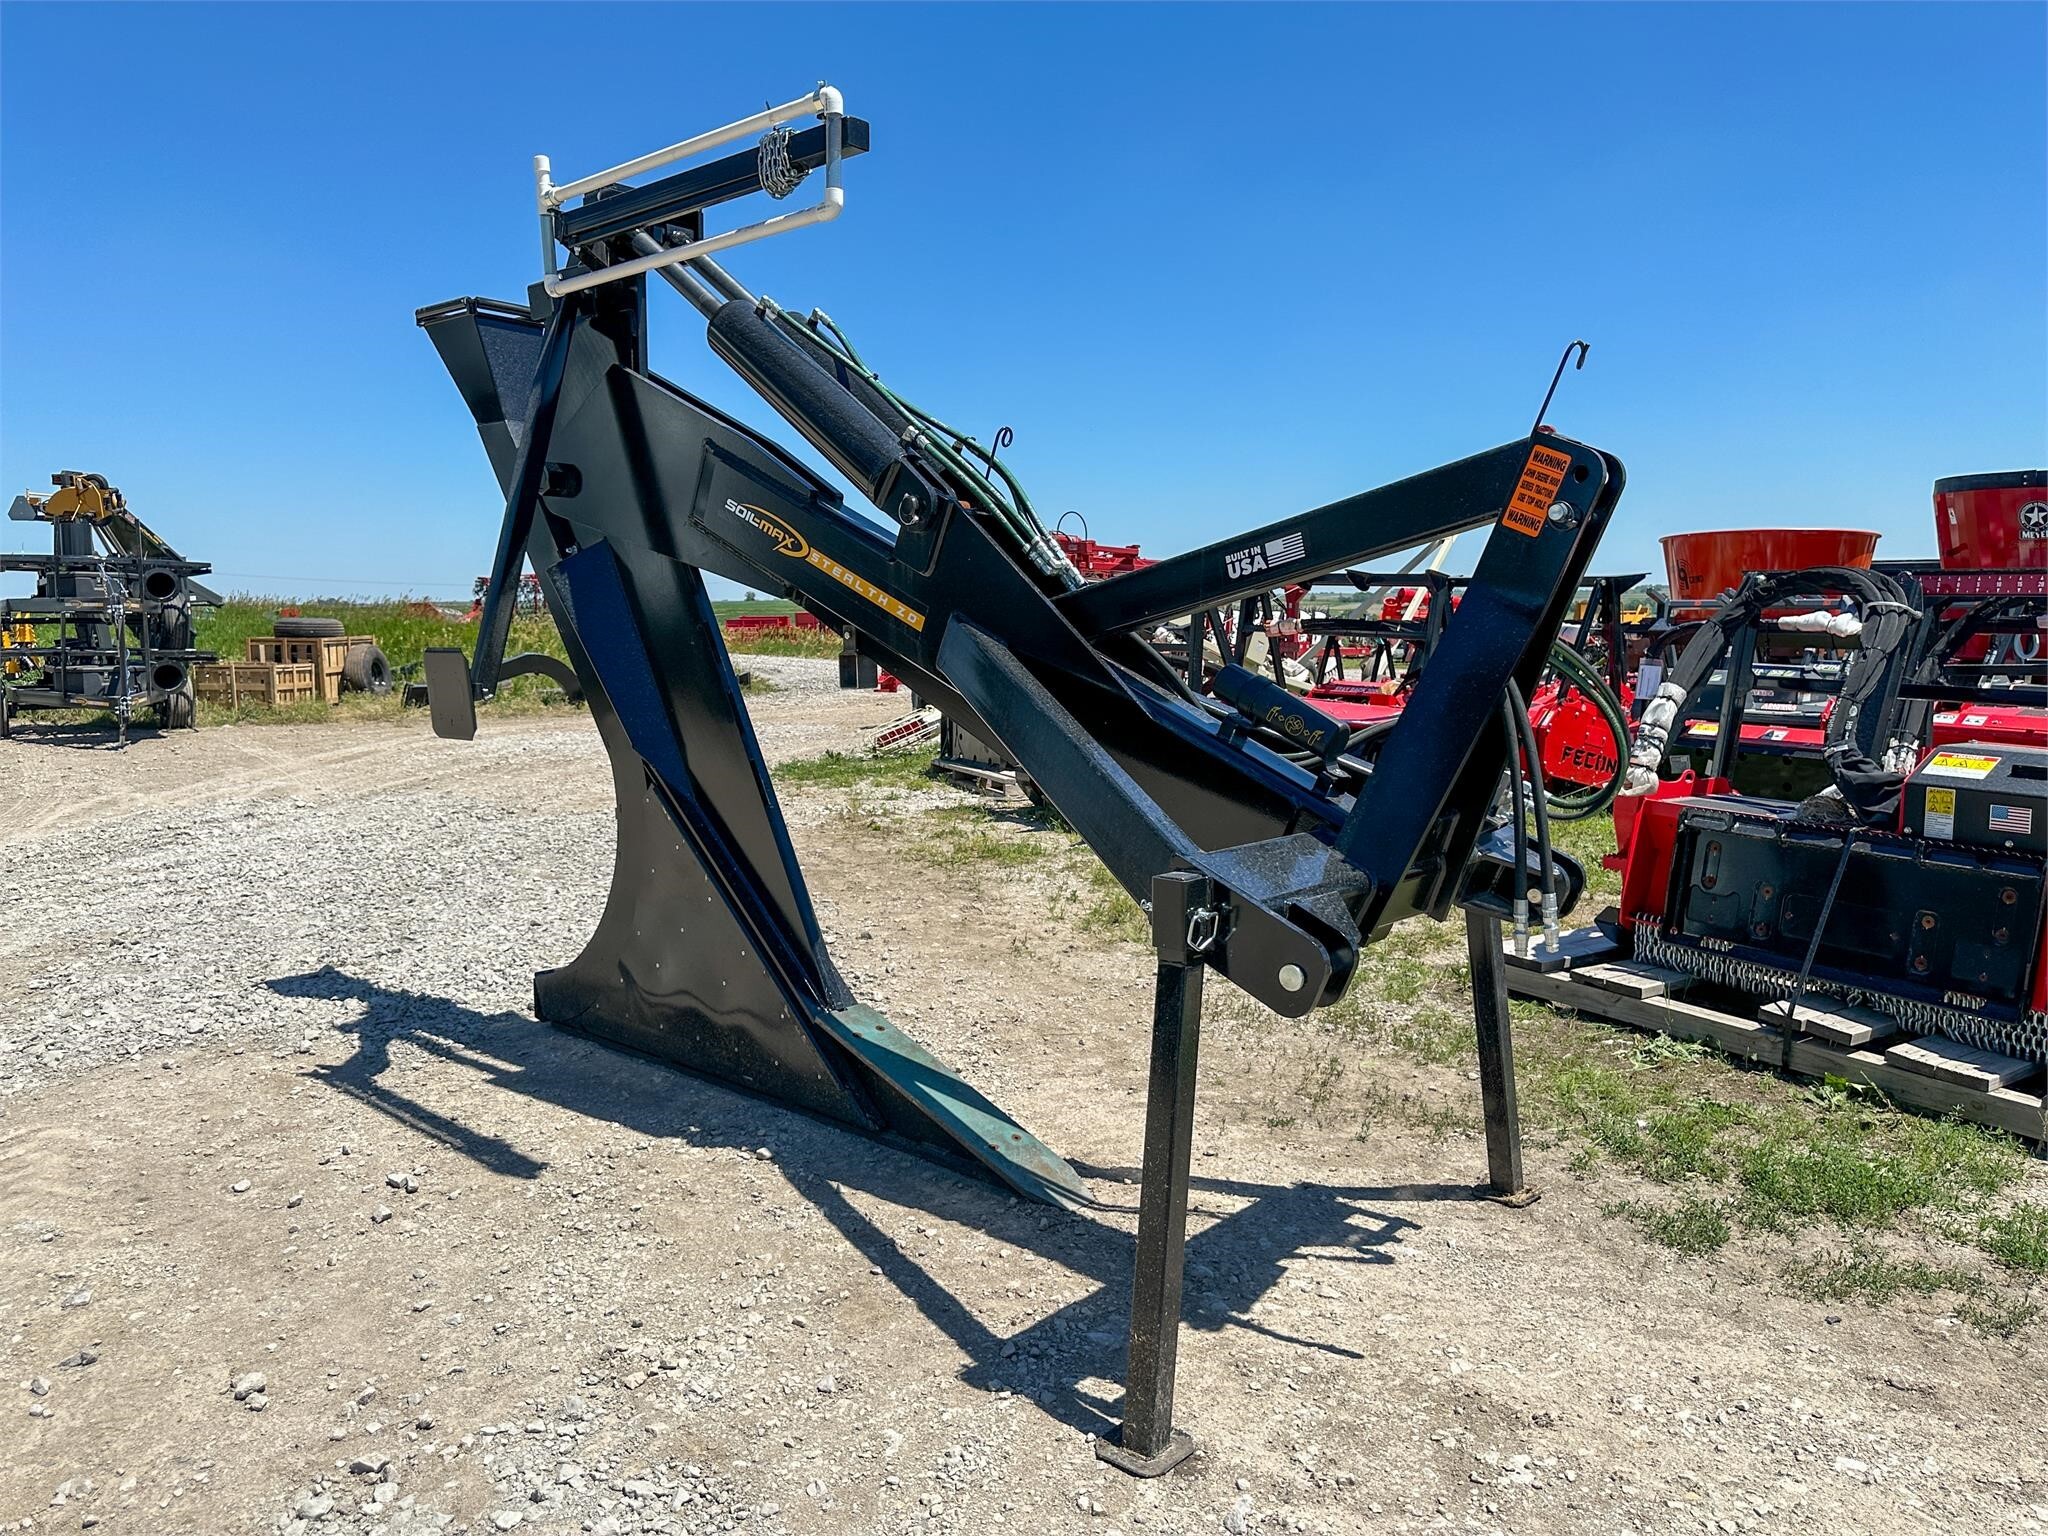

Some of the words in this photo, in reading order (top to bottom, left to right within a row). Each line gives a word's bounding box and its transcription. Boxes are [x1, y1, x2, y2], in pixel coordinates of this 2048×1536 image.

[1532, 450, 1567, 471] WARNING
[1520, 479, 1535, 492] SERIES
[1533, 484, 1554, 499] TRACTORS
[1517, 492, 1527, 502] USE
[1526, 495, 1535, 506] TOP
[1534, 497, 1547, 510] HOLE
[724, 497, 796, 552] SOIL-MAX
[1507, 509, 1542, 531] WARNING
[1225, 549, 1250, 564] BUILT
[1250, 545, 1261, 556] IN
[1227, 554, 1267, 579] USA
[810, 551, 889, 606] STEALTH
[1561, 745, 1618, 774] FECON
